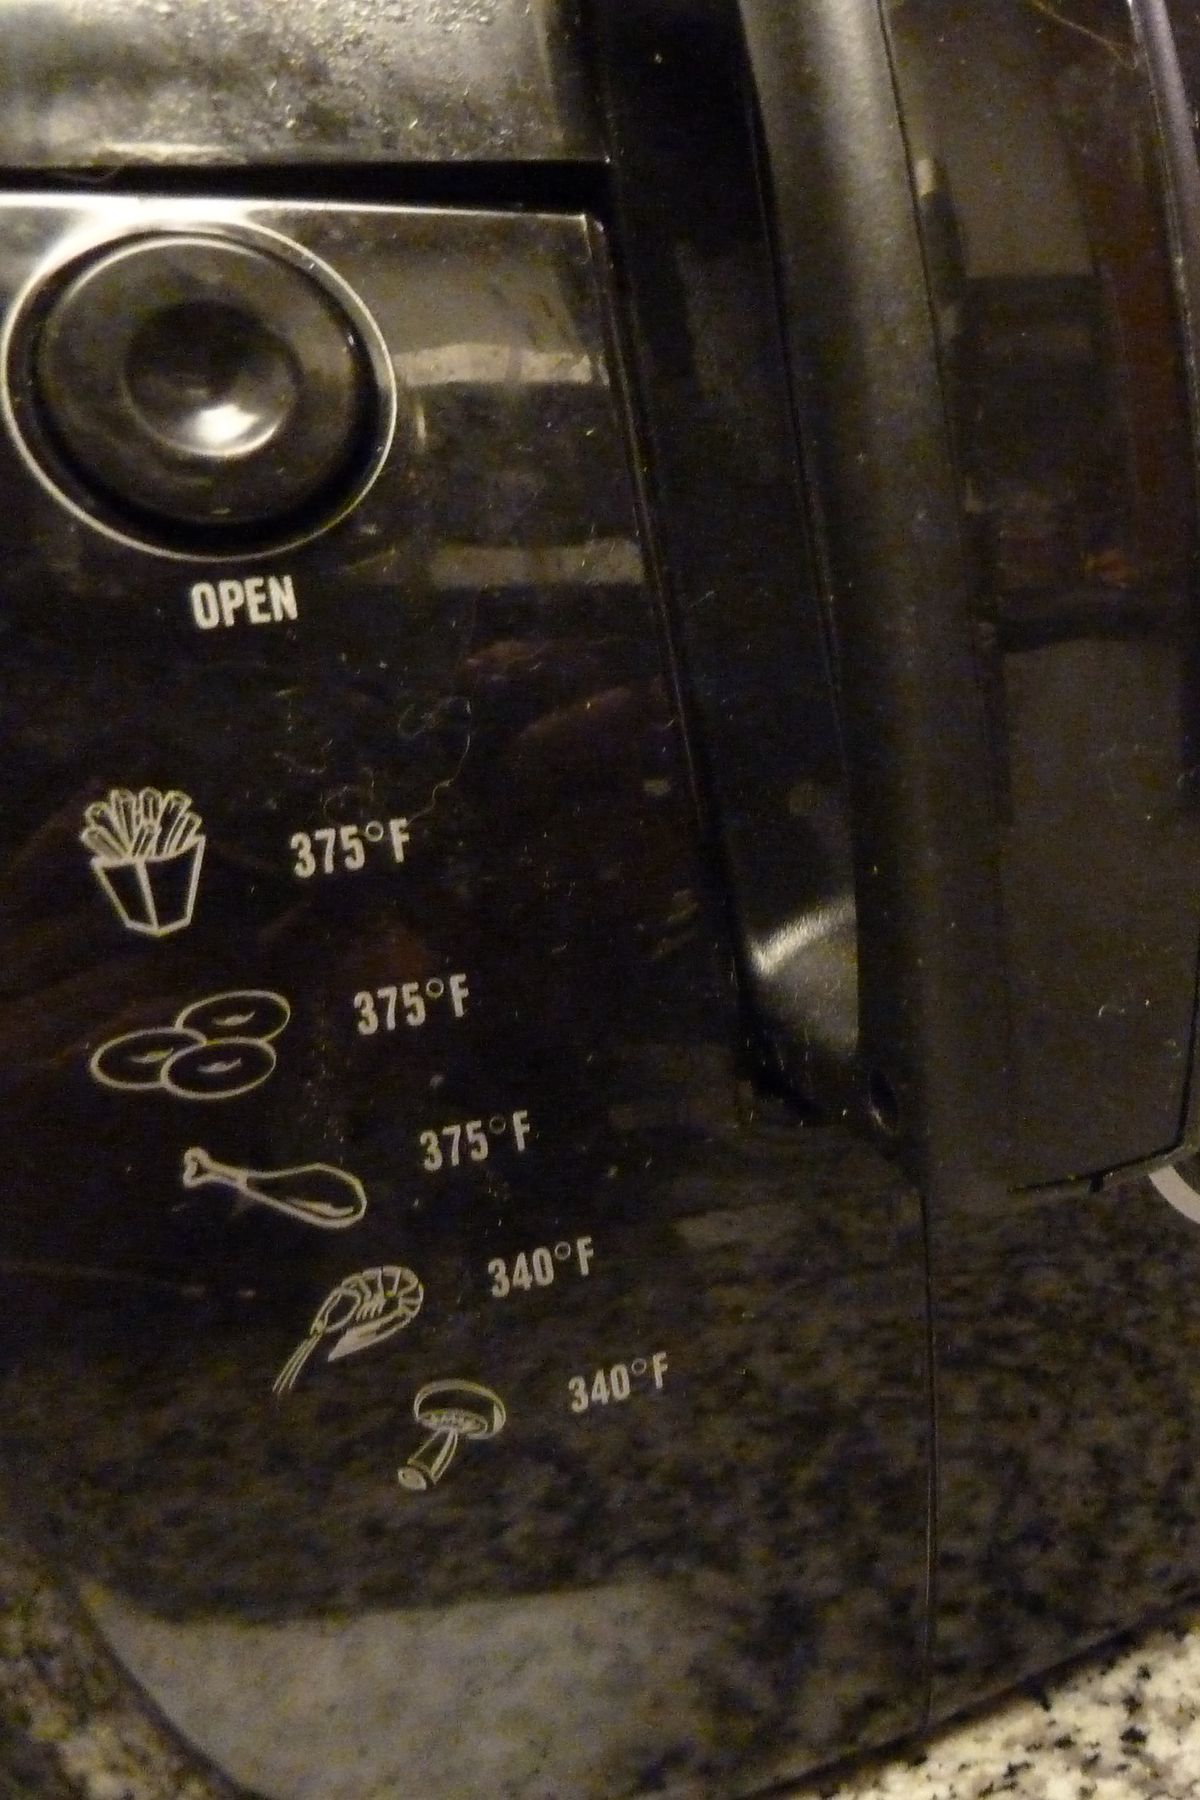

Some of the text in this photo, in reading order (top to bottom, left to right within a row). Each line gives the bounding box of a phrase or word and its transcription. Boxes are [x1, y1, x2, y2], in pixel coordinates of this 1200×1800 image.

[191, 575, 298, 630] OPEN
[290, 817, 410, 878] 375°F
[353, 973, 470, 1036] 375°F
[420, 1110, 530, 1172] 375°F
[488, 1236, 594, 1298] 340°F
[568, 1352, 668, 1413] 340°F
